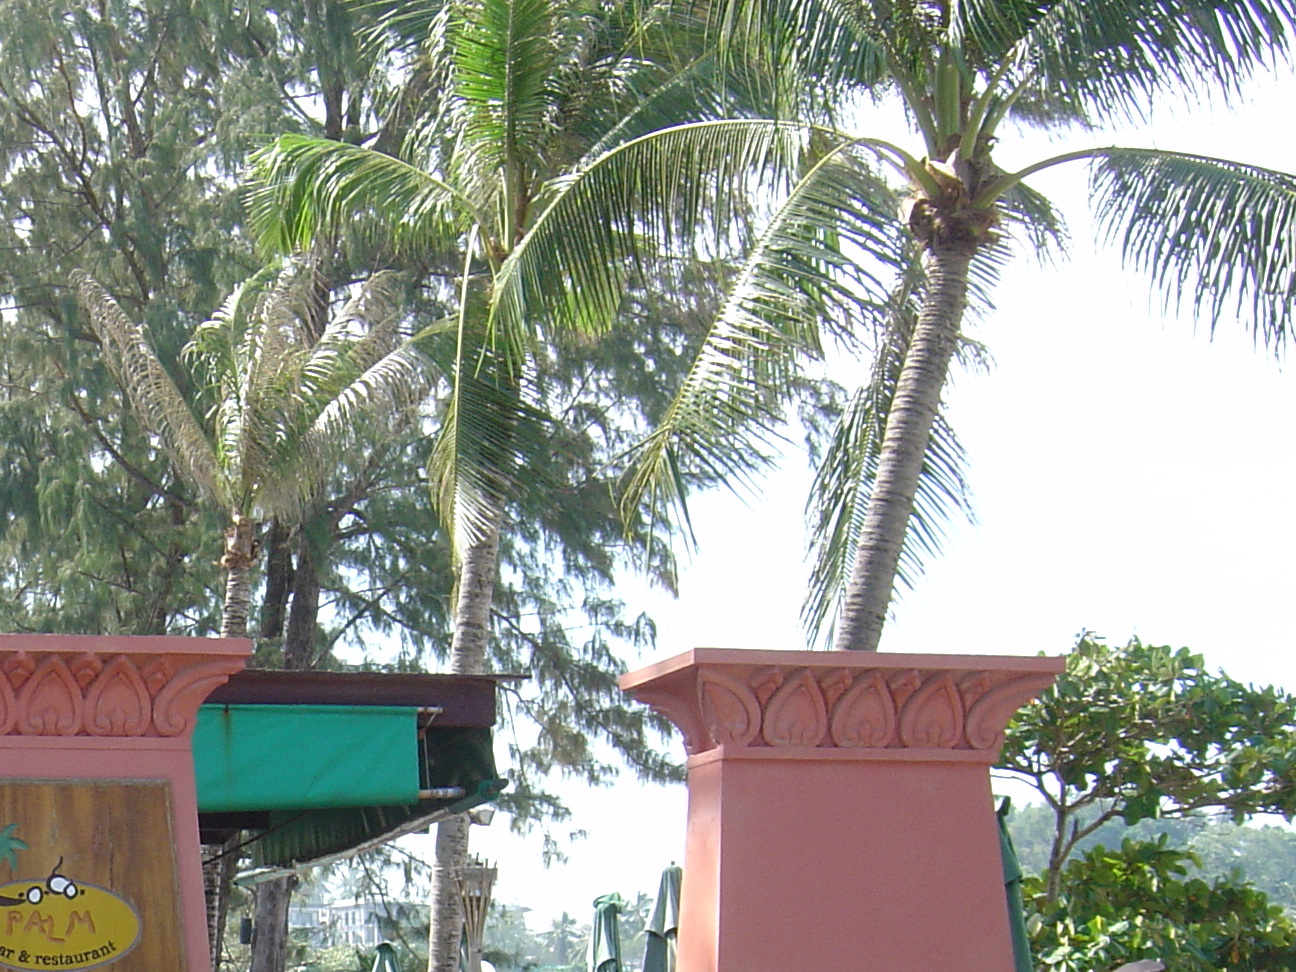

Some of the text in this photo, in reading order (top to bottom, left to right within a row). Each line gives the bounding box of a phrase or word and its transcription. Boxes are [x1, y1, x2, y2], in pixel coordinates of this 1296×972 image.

[5, 910, 96, 943] PALM
[18, 949, 30, 964] &
[35, 940, 117, 966] restaurant
